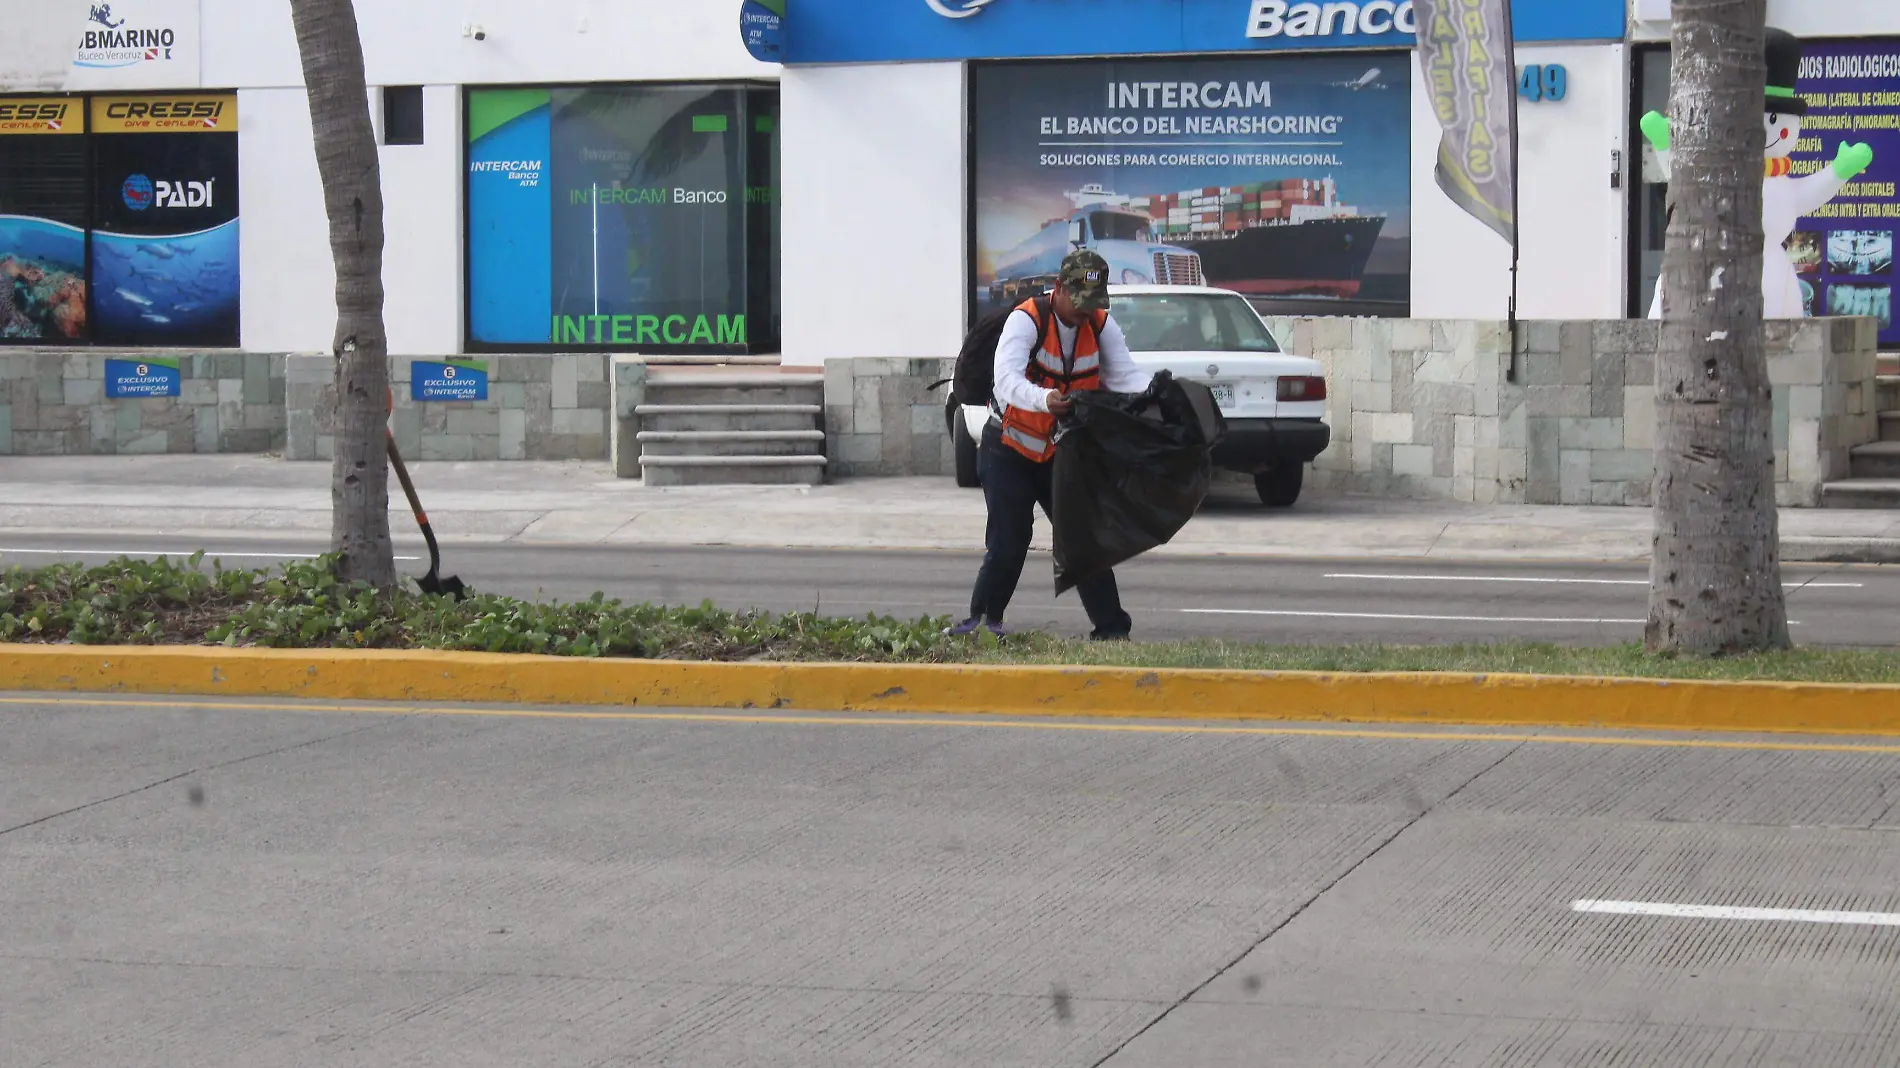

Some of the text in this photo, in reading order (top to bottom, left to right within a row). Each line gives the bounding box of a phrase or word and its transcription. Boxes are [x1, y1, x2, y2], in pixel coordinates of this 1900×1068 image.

[79, 28, 174, 49] BMARINO
[750, 30, 762, 38] ATM
[78, 50, 141, 60] Buceo Veracruz
[1519, 64, 1567, 103] 49
[1108, 81, 1272, 109] INTERCAM
[1792, 92, 1827, 107] GRAMA
[1862, 92, 1871, 106] DE
[106, 101, 224, 119] CRESSI
[1040, 118, 1062, 135] EL
[1067, 117, 1139, 135] BANCO
[1143, 117, 1181, 135] DEL
[1853, 115, 1900, 133] (PANORAMICA
[1792, 135, 1822, 152] GRAFÍA
[470, 160, 541, 172] INTERCAM
[1040, 154, 1343, 166] SOLUCIONES PARA COMERCIO INTERNACIONAL.
[508, 171, 539, 180] Banco
[156, 180, 213, 208] PADI
[570, 188, 727, 204] INTERCAM Banco
[1861, 182, 1895, 197] DIGITALES
[1857, 203, 1862, 217] Y
[1862, 203, 1881, 217] EXTRA
[552, 315, 746, 344] INTERCAM
[117, 376, 168, 384] EXCLUSIVO
